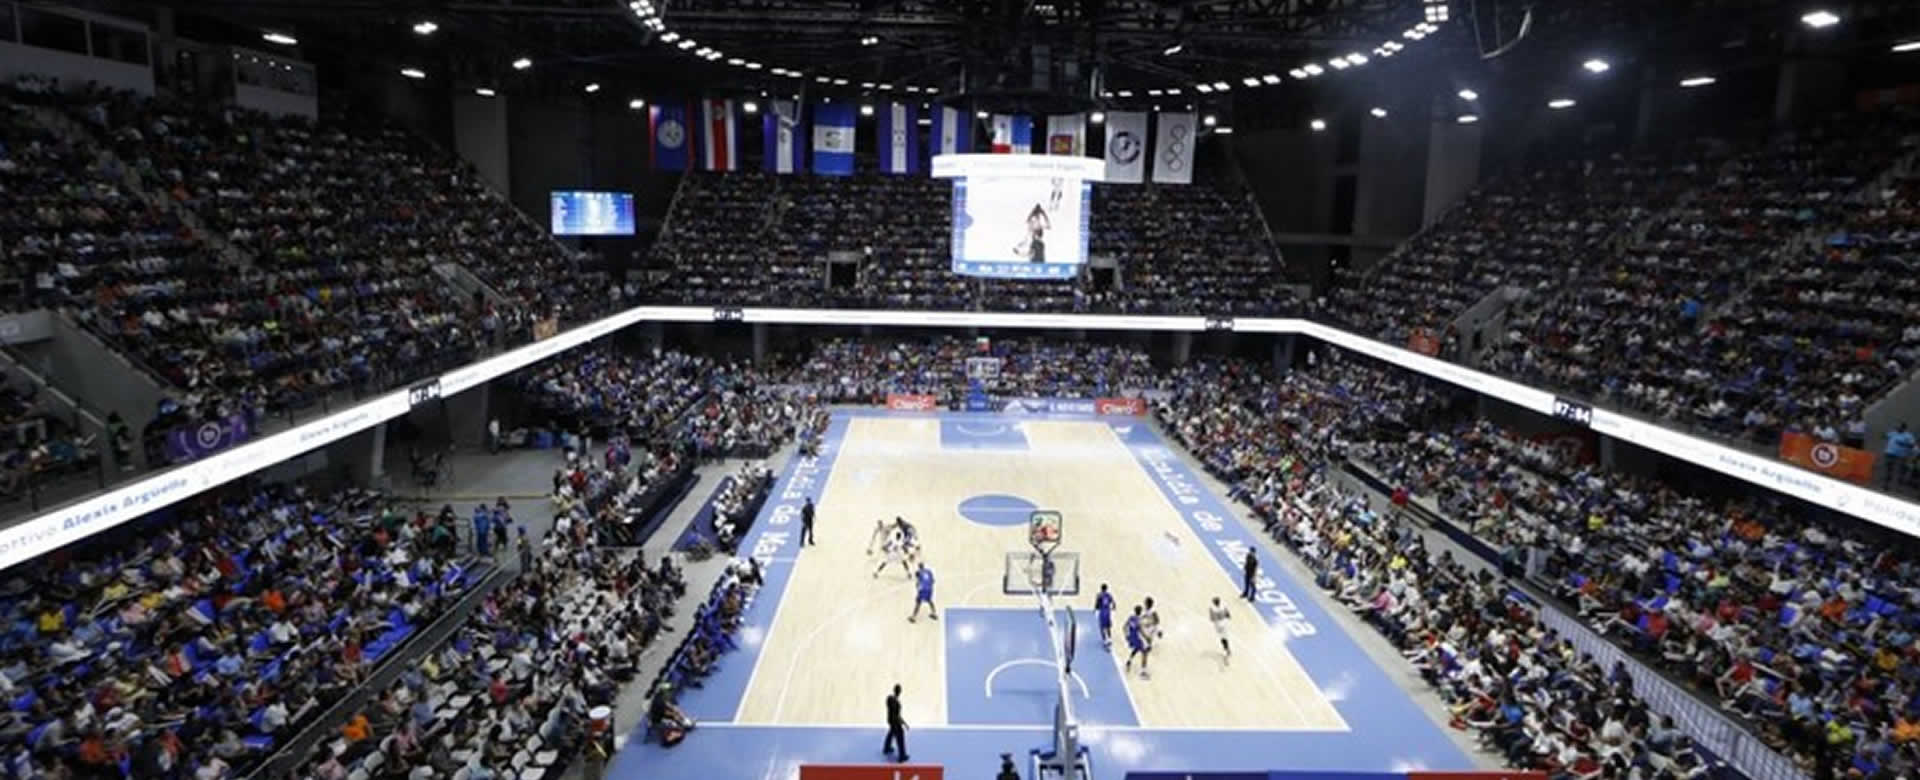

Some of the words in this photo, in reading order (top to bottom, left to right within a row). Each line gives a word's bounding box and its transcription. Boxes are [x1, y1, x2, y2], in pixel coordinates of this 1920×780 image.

[61, 503, 118, 531] Alexis
[769, 504, 800, 526] de
[1192, 511, 1223, 531] de
